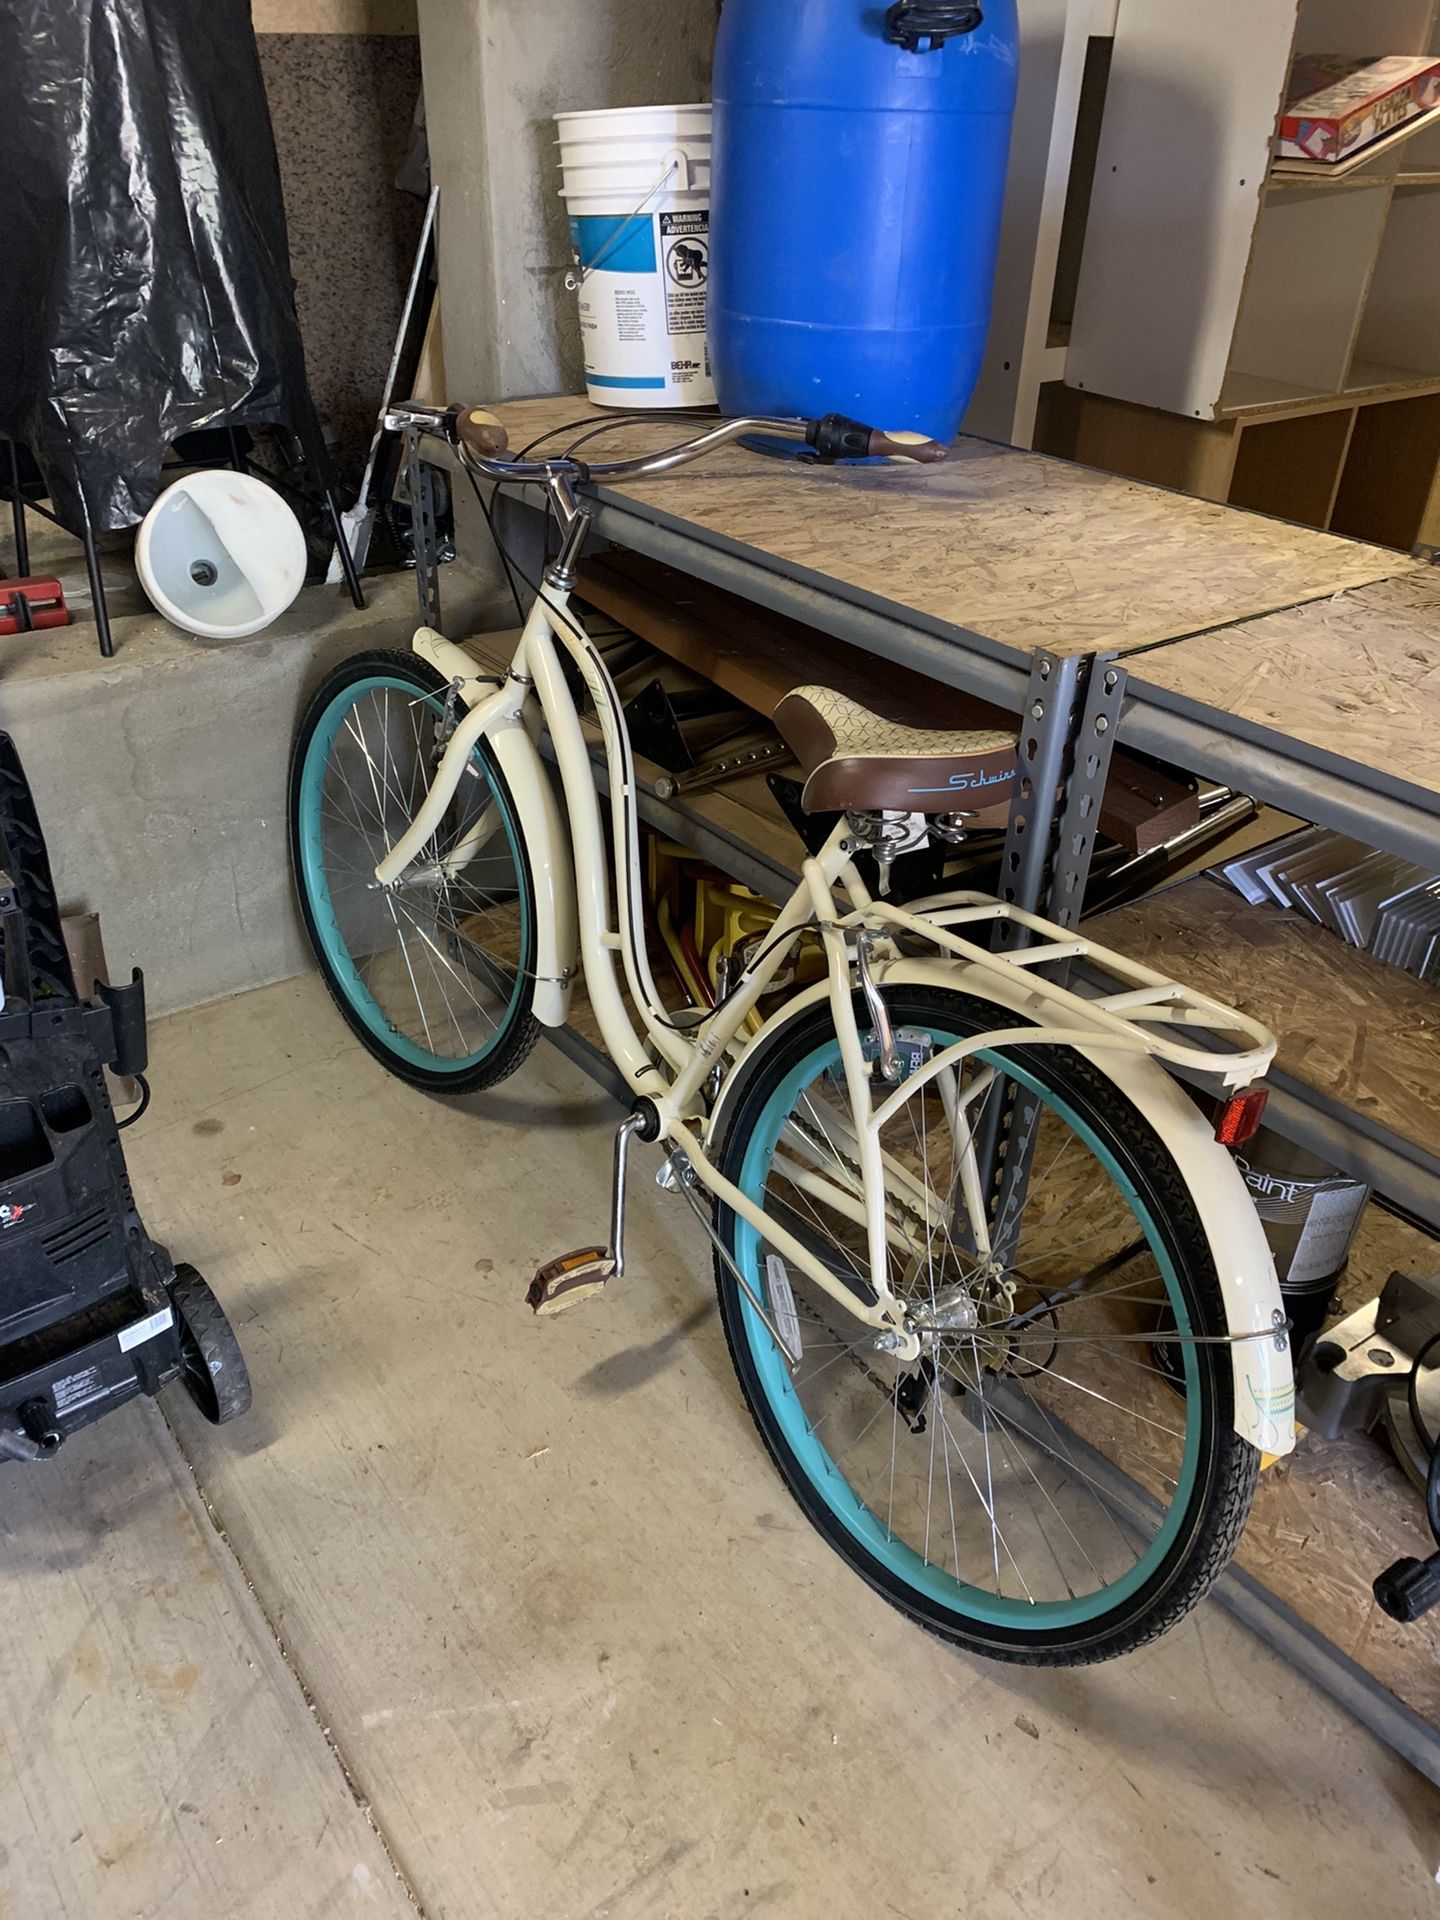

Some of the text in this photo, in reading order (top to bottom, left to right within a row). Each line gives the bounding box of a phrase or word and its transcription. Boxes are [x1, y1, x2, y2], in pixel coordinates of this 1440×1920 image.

[672, 213, 702, 223] WARNING
[671, 360, 692, 370] BEHR
[909, 1052, 923, 1076] BEH
